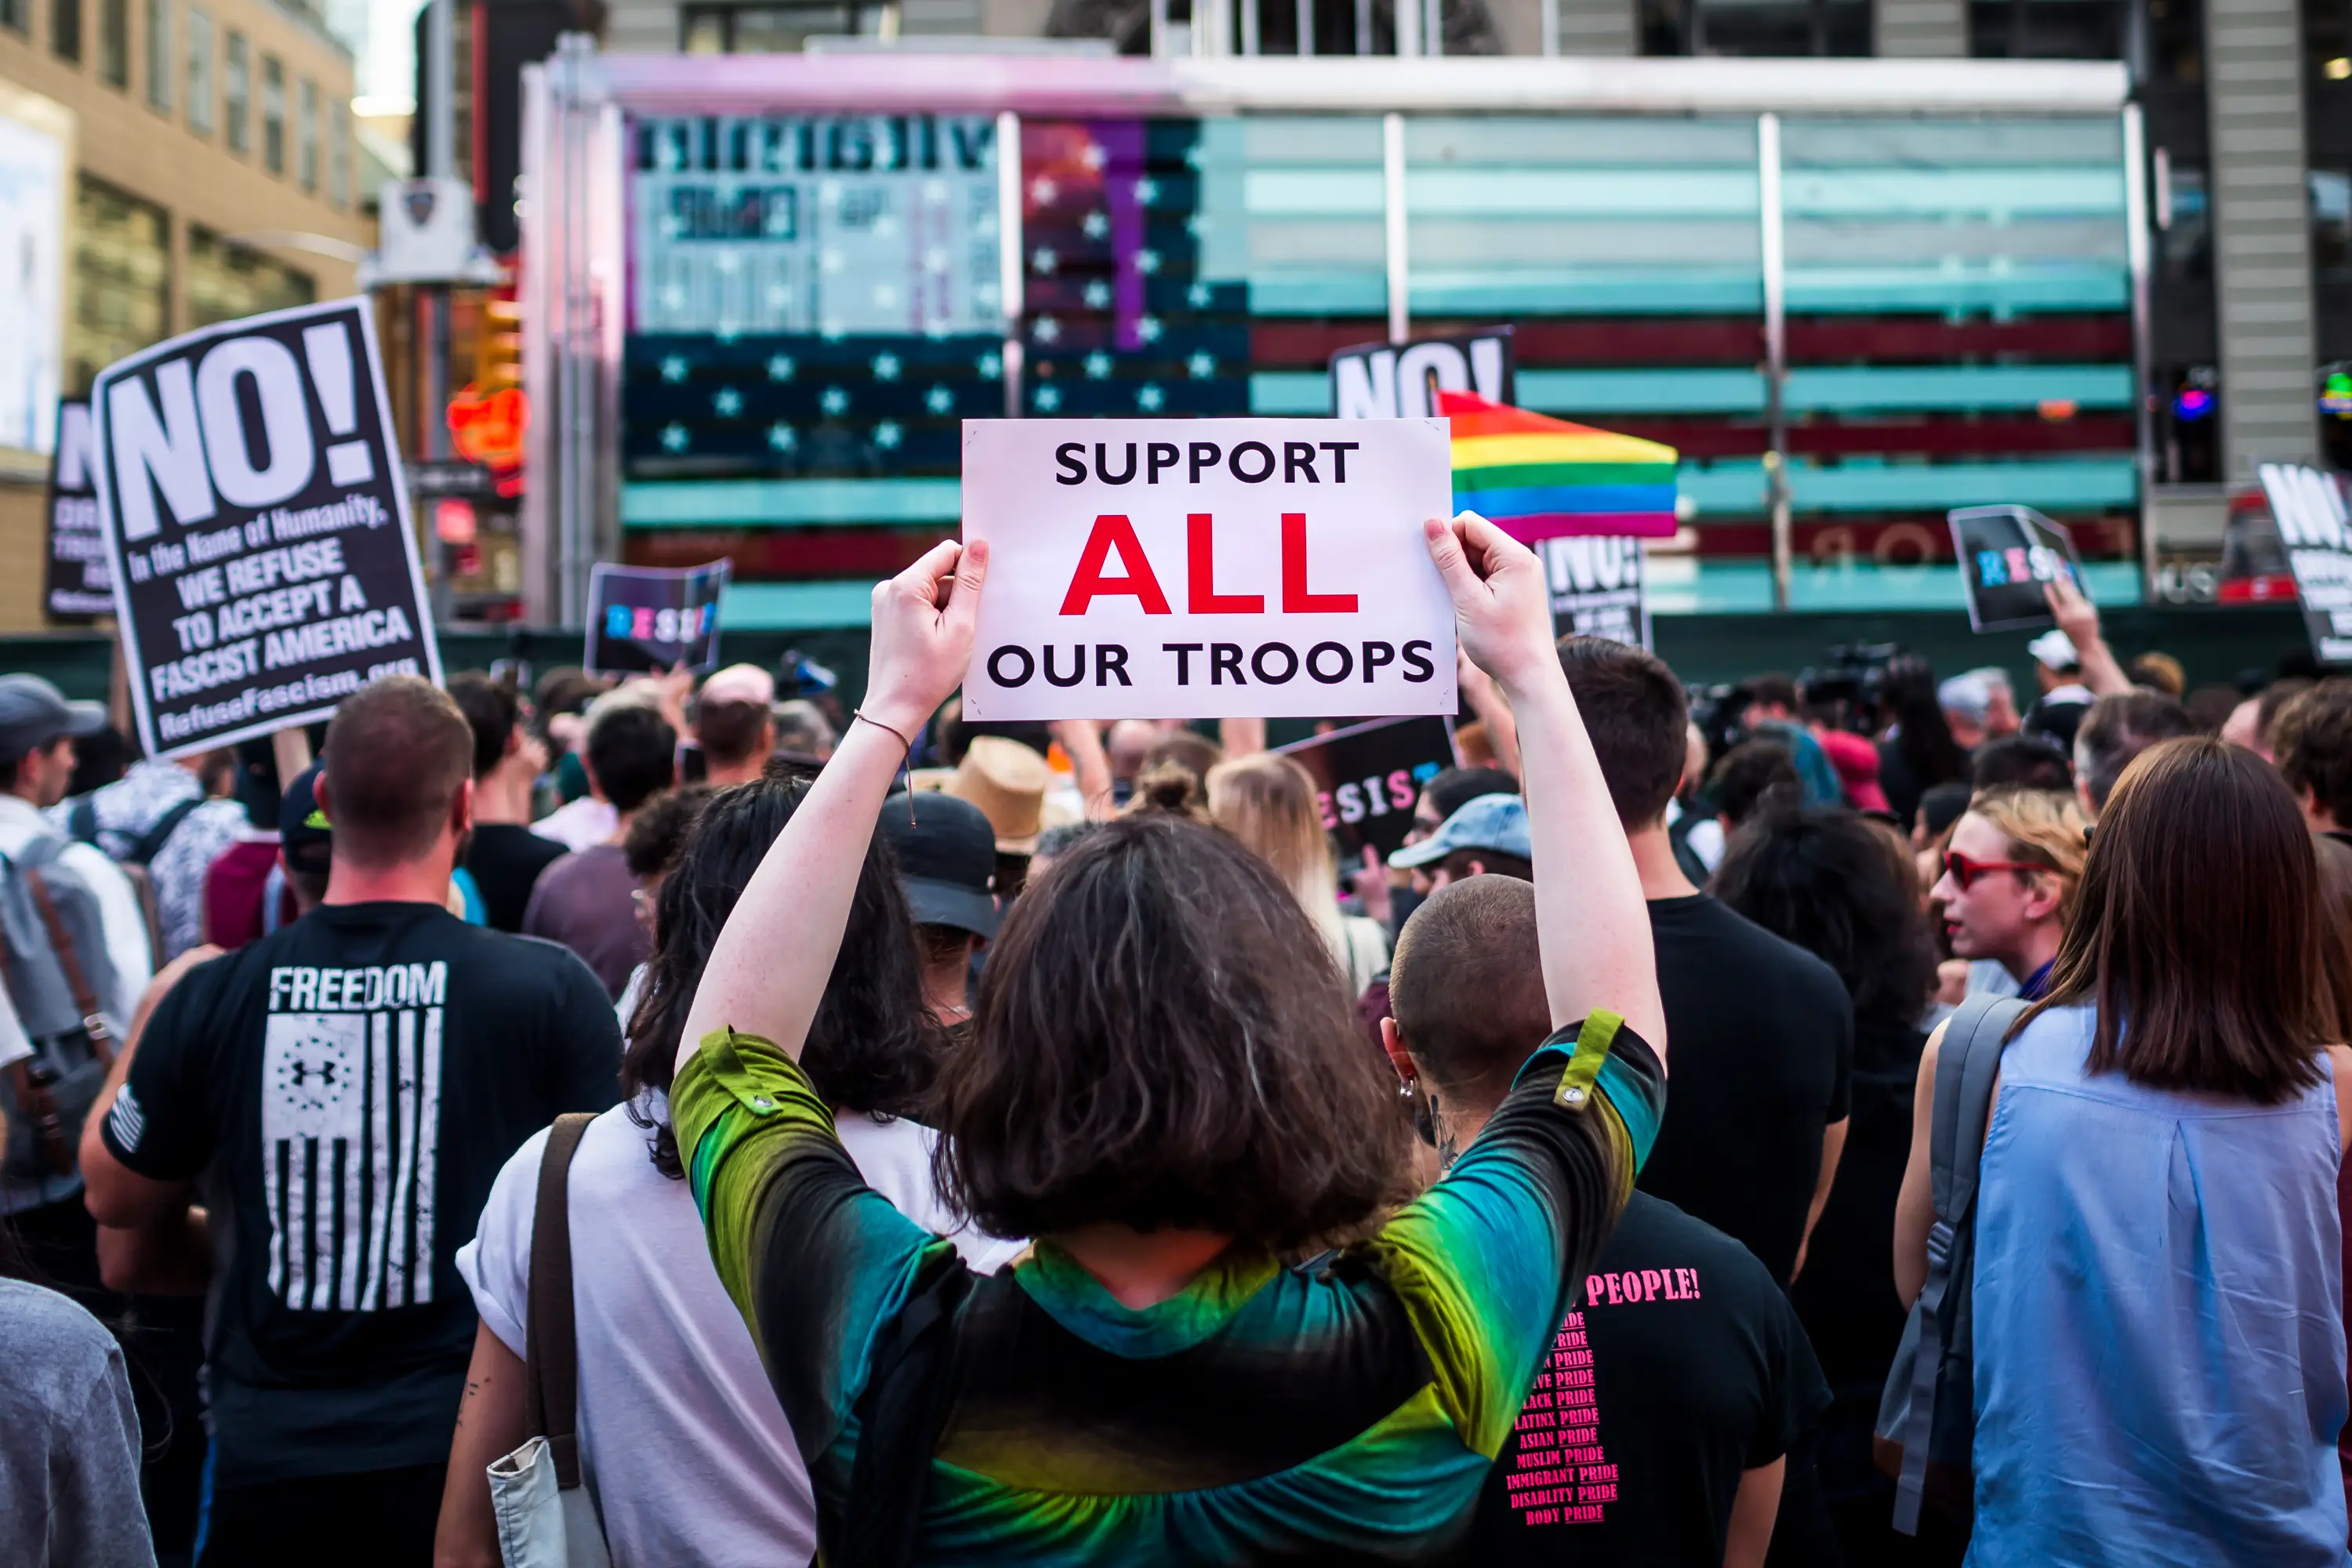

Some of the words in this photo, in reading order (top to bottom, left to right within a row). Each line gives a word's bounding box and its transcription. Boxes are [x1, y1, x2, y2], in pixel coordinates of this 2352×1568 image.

[108, 321, 375, 543] NO!
[1055, 441, 1359, 485] SUPPORT
[128, 550, 151, 583] In
[151, 542, 187, 575] the
[186, 526, 244, 564] Name
[244, 511, 270, 548] of
[271, 493, 390, 543] Humanity,
[176, 565, 227, 612] WE
[225, 536, 346, 597] REFUSE
[1059, 513, 1359, 615] ALL
[172, 612, 215, 652] TO
[219, 579, 333, 642] ACCEPT
[339, 575, 368, 612] A
[151, 637, 260, 702] FASCIST
[264, 606, 413, 670] AMERICA
[986, 644, 1133, 688] OUR
[1162, 640, 1435, 685] TROOPS
[268, 960, 448, 1011] FREEDOM
[1585, 1268, 1700, 1307] PEOPLE!
[1552, 1330, 1588, 1348] RIDE
[1554, 1349, 1594, 1367] PRIDE
[1555, 1369, 1595, 1387] PRIDE
[1556, 1388, 1596, 1406] PRIDE
[1514, 1412, 1556, 1431] LATINX
[1559, 1407, 1599, 1425] PRIDE
[1520, 1432, 1555, 1450] ASIAN
[1557, 1427, 1598, 1445] PRIDE
[1516, 1450, 1561, 1469] MUSLIM
[1565, 1446, 1604, 1464] PRIDE
[1506, 1468, 1575, 1490] IMMIGRANT
[1578, 1464, 1619, 1482] PRIDE
[1577, 1483, 1618, 1501] PRIDE
[1526, 1508, 1559, 1526] BODY
[1564, 1504, 1604, 1522] PRIDE
